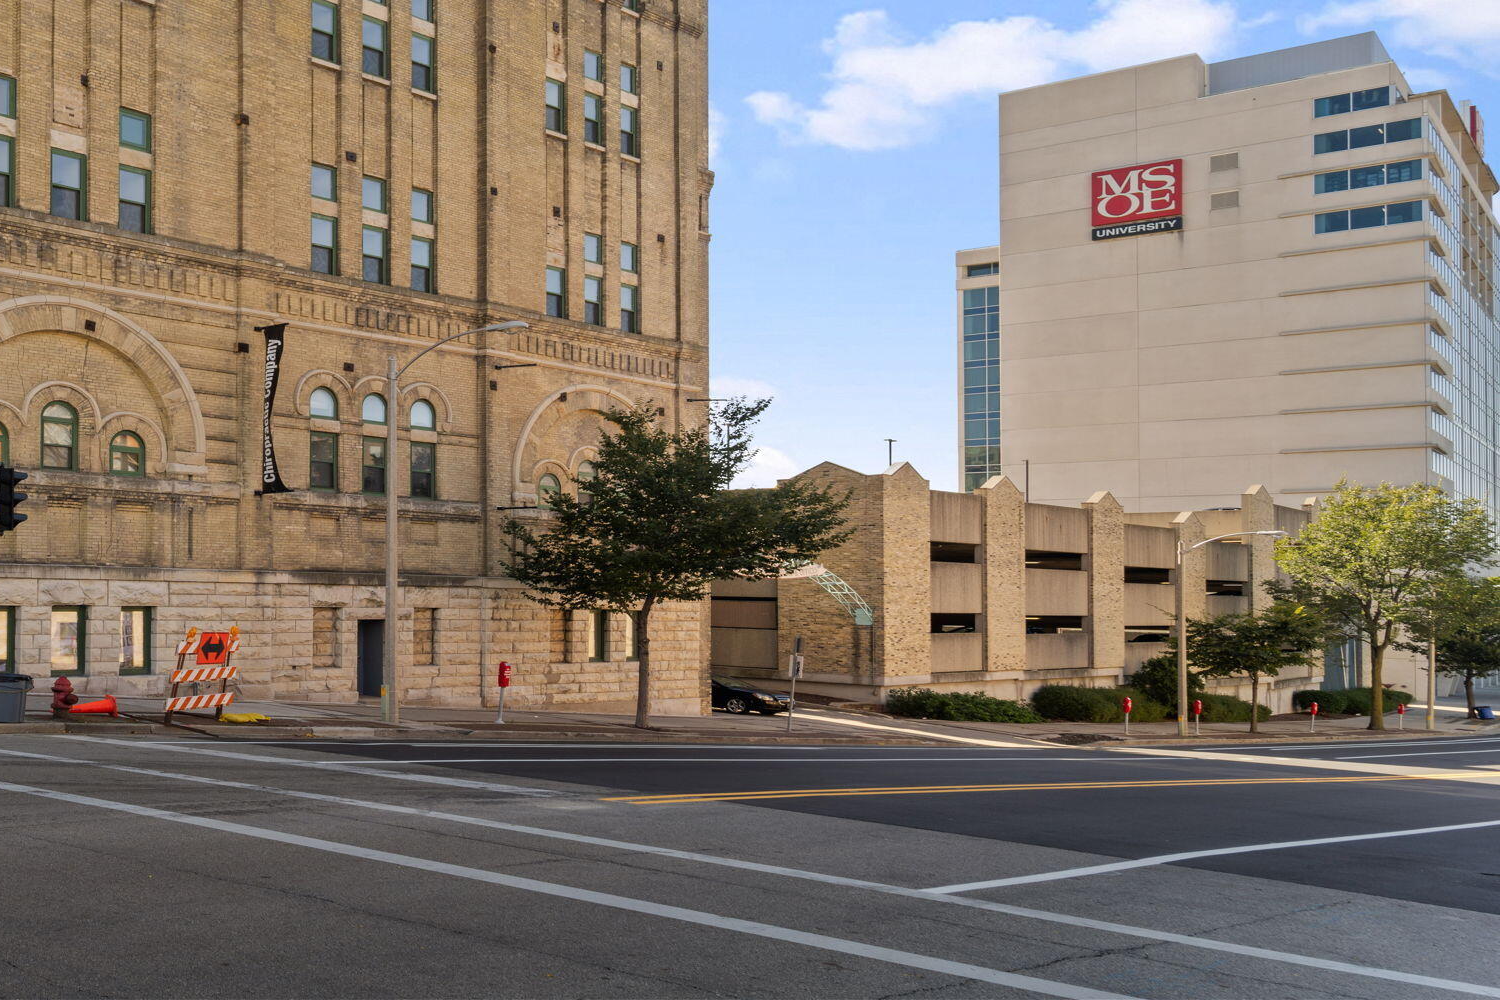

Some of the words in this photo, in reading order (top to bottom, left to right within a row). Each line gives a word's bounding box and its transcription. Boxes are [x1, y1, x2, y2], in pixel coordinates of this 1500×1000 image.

[1096, 219, 1177, 238] UNIVERSITY
[264, 339, 282, 398] Company
[263, 400, 276, 484] Chiropractic
